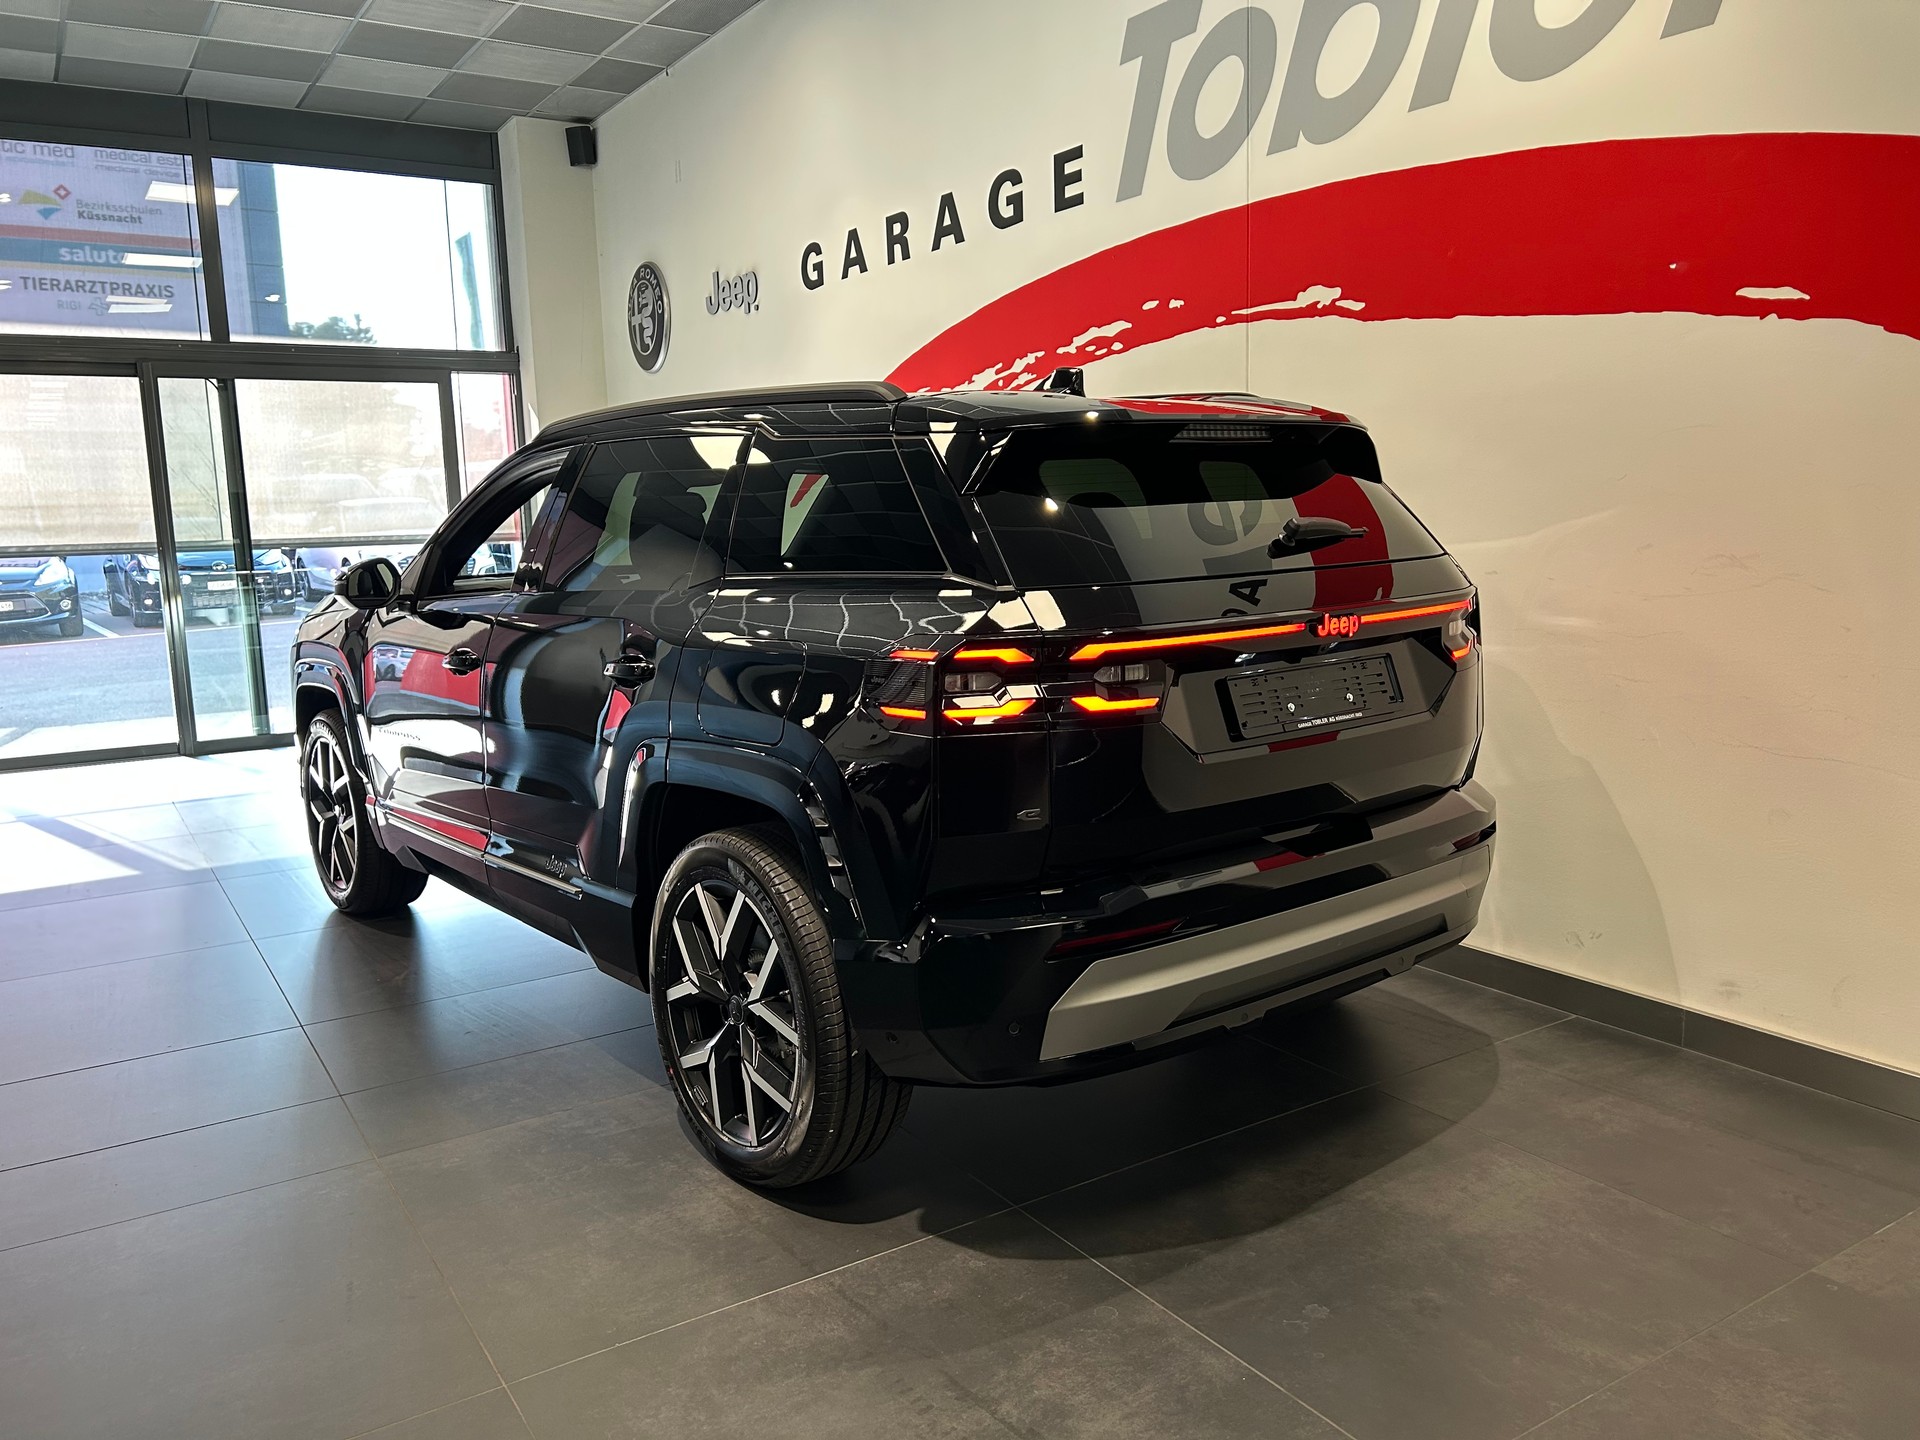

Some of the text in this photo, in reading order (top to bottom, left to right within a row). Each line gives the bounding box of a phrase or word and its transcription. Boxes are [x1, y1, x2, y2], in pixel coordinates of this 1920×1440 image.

[33, 143, 75, 159] med
[94, 147, 151, 164] medical
[76, 199, 162, 215] Bezirksschulen
[77, 210, 143, 224] Küssnacht
[801, 144, 1085, 290] GARAGE
[59, 245, 125, 264] salut
[19, 276, 174, 298] TIERARZTPRAXIS
[639, 267, 663, 314] ROMEO
[705, 270, 758, 315] Jeep
[57, 299, 81, 311] RIGI
[1317, 612, 1359, 637] Jeep
[1312, 717, 1328, 725] TOBLER
